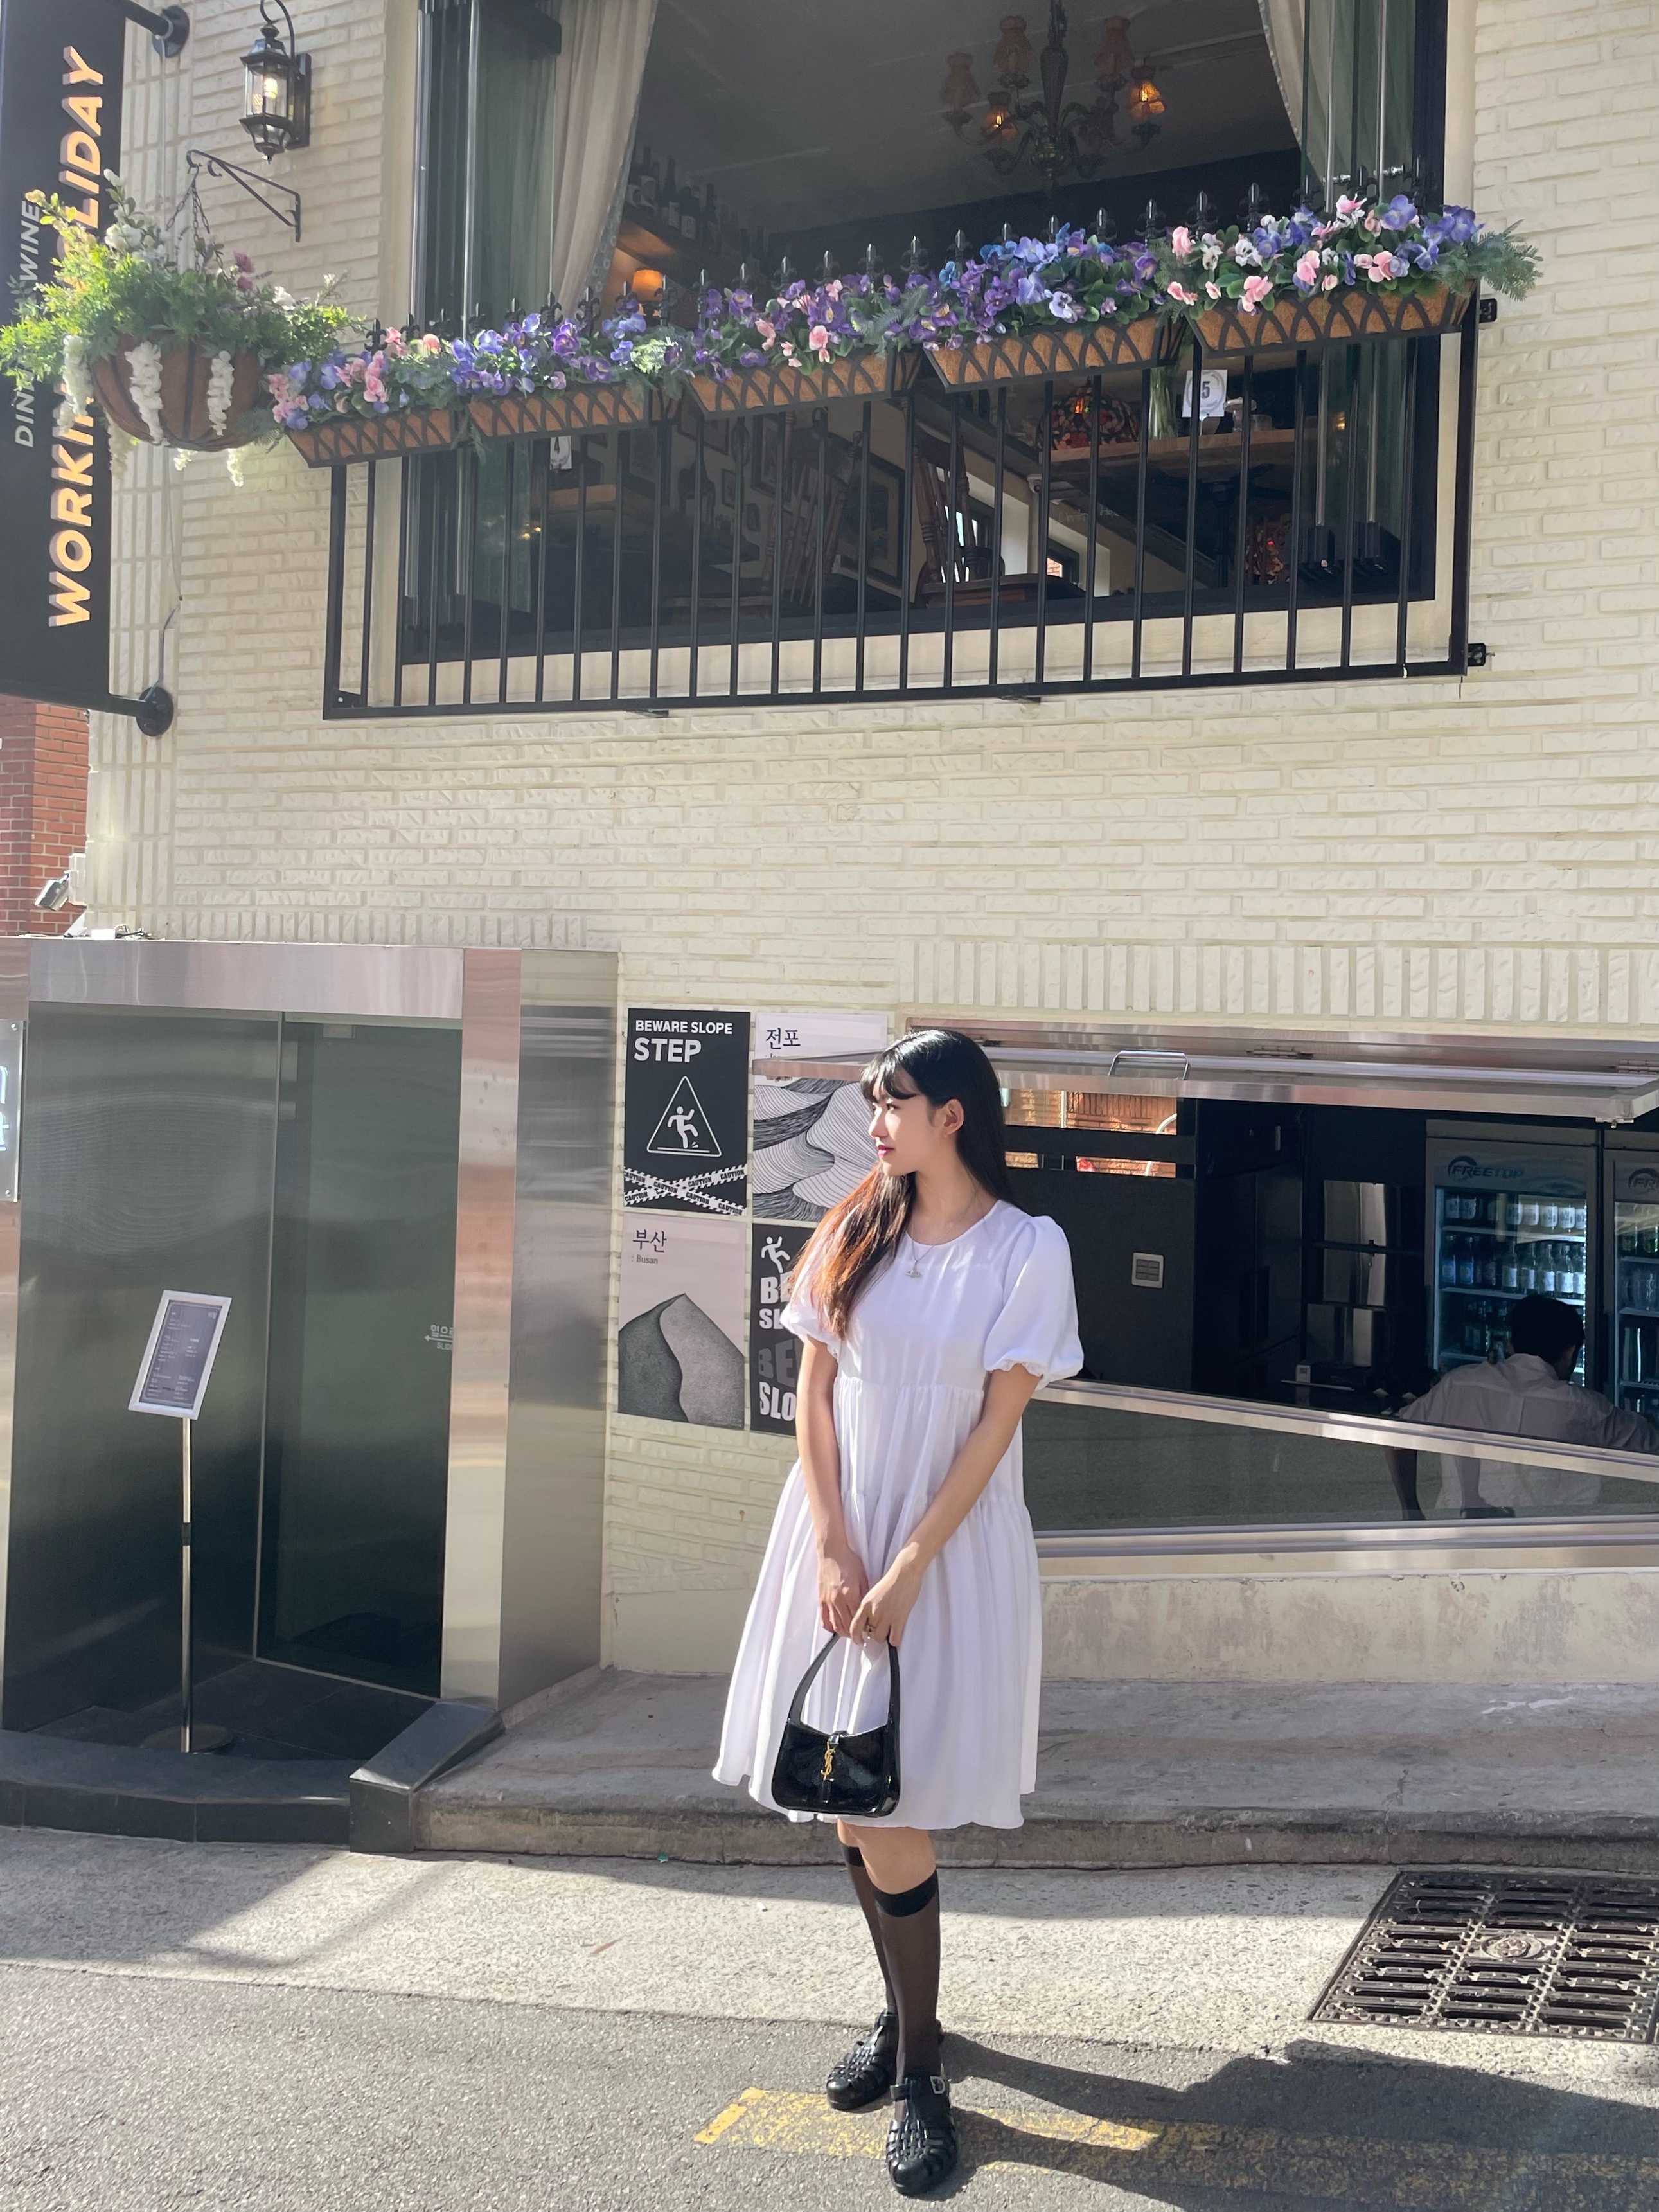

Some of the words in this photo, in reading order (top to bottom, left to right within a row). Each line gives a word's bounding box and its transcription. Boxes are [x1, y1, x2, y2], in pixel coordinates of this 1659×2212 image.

[57, 45, 103, 297] LIDAY
[19, 201, 40, 281] WINE
[1201, 381, 1210, 399] 5
[49, 380, 94, 627] WORKI
[635, 1019, 688, 1033] BEWARE
[691, 1022, 732, 1035] SLOPE
[765, 1027, 801, 1050] 전포
[634, 1037, 702, 1063] STEP
[625, 1191, 648, 1202] CAUTION
[688, 1176, 712, 1187] CAUTION
[720, 1169, 745, 1179] CAUTION
[653, 1181, 678, 1193] CAUTION
[686, 1191, 709, 1204] CAUTION
[718, 1202, 743, 1216] CAUTION
[632, 1229, 667, 1253] 부산
[636, 1254, 658, 1264] Busan
